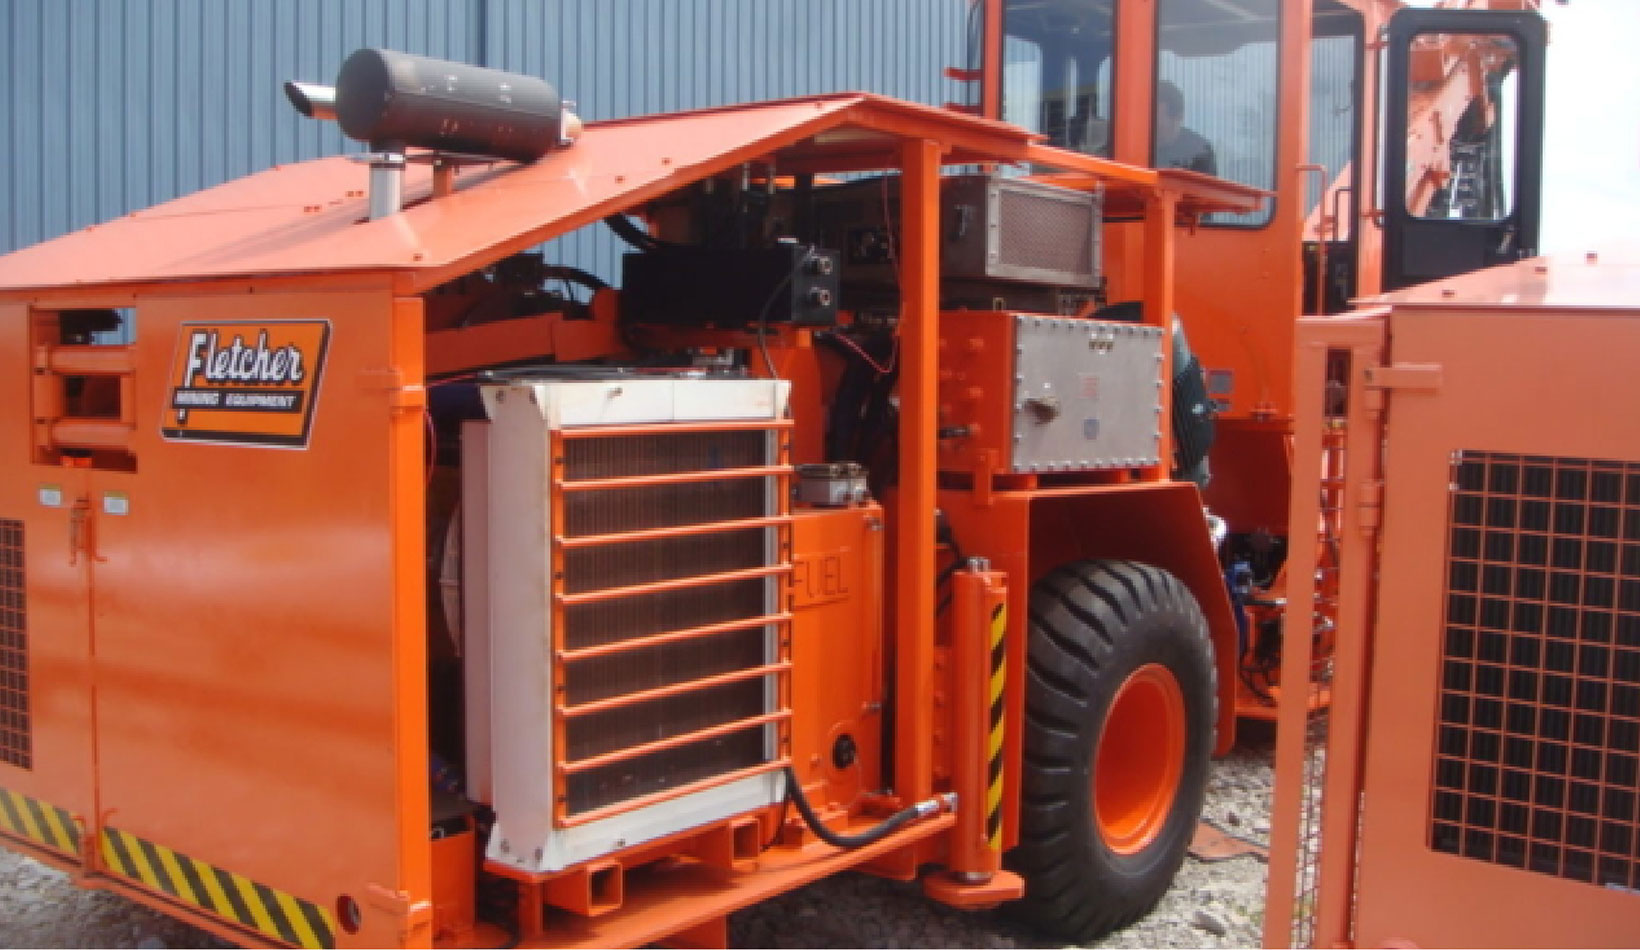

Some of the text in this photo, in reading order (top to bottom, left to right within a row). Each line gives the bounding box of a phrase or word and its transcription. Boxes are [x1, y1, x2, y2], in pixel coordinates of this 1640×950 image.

[182, 330, 305, 389] Fletcher
[174, 389, 297, 409] MINING EQUIPMENT
